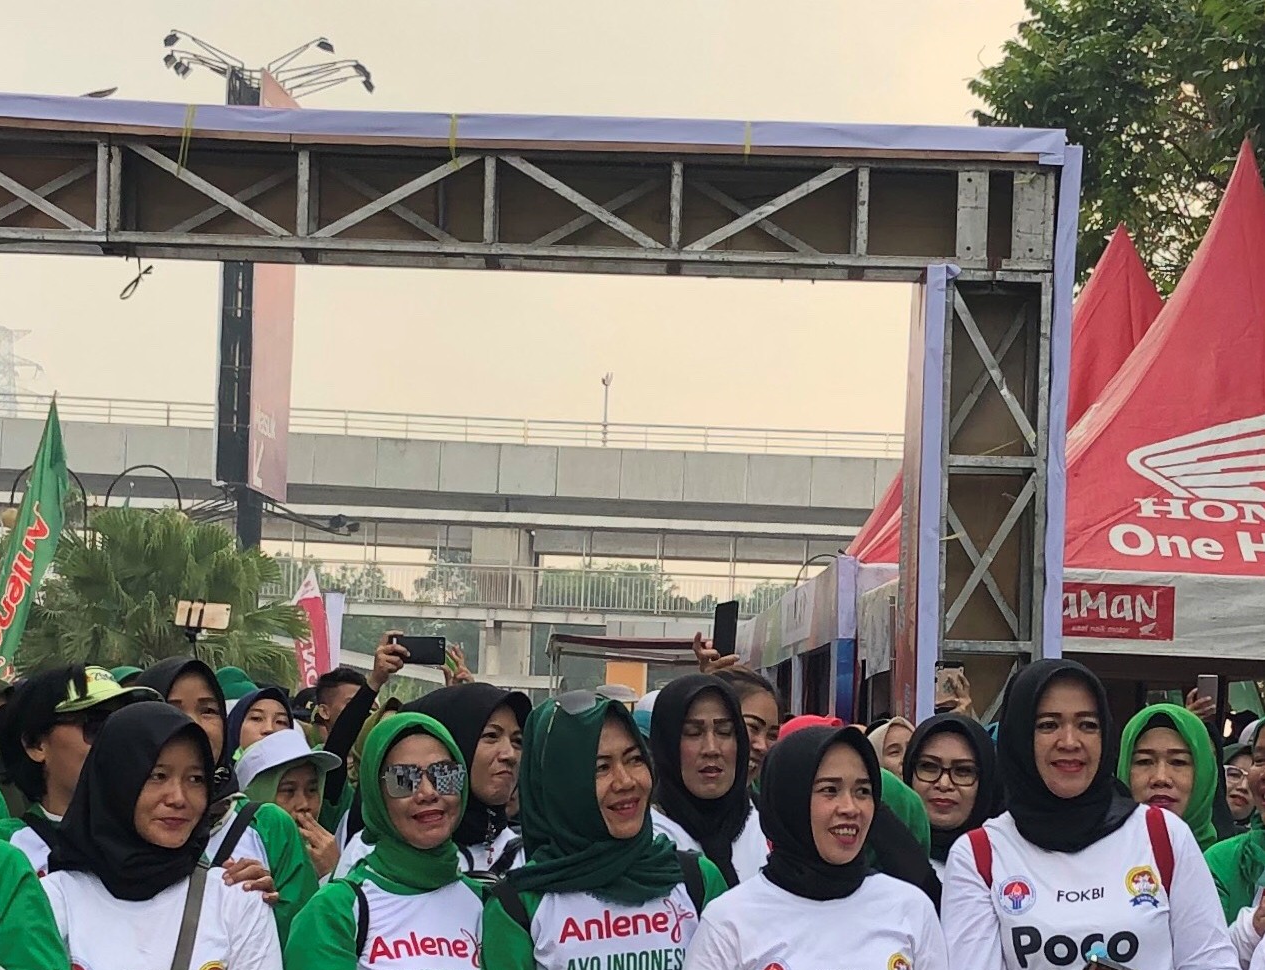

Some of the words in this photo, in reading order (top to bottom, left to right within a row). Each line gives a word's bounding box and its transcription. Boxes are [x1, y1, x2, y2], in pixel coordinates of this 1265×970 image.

[1109, 523, 1225, 562] One
[1057, 887, 1104, 903] FOKBI
[559, 909, 670, 943] Anlene
[369, 931, 468, 964] Anlene
